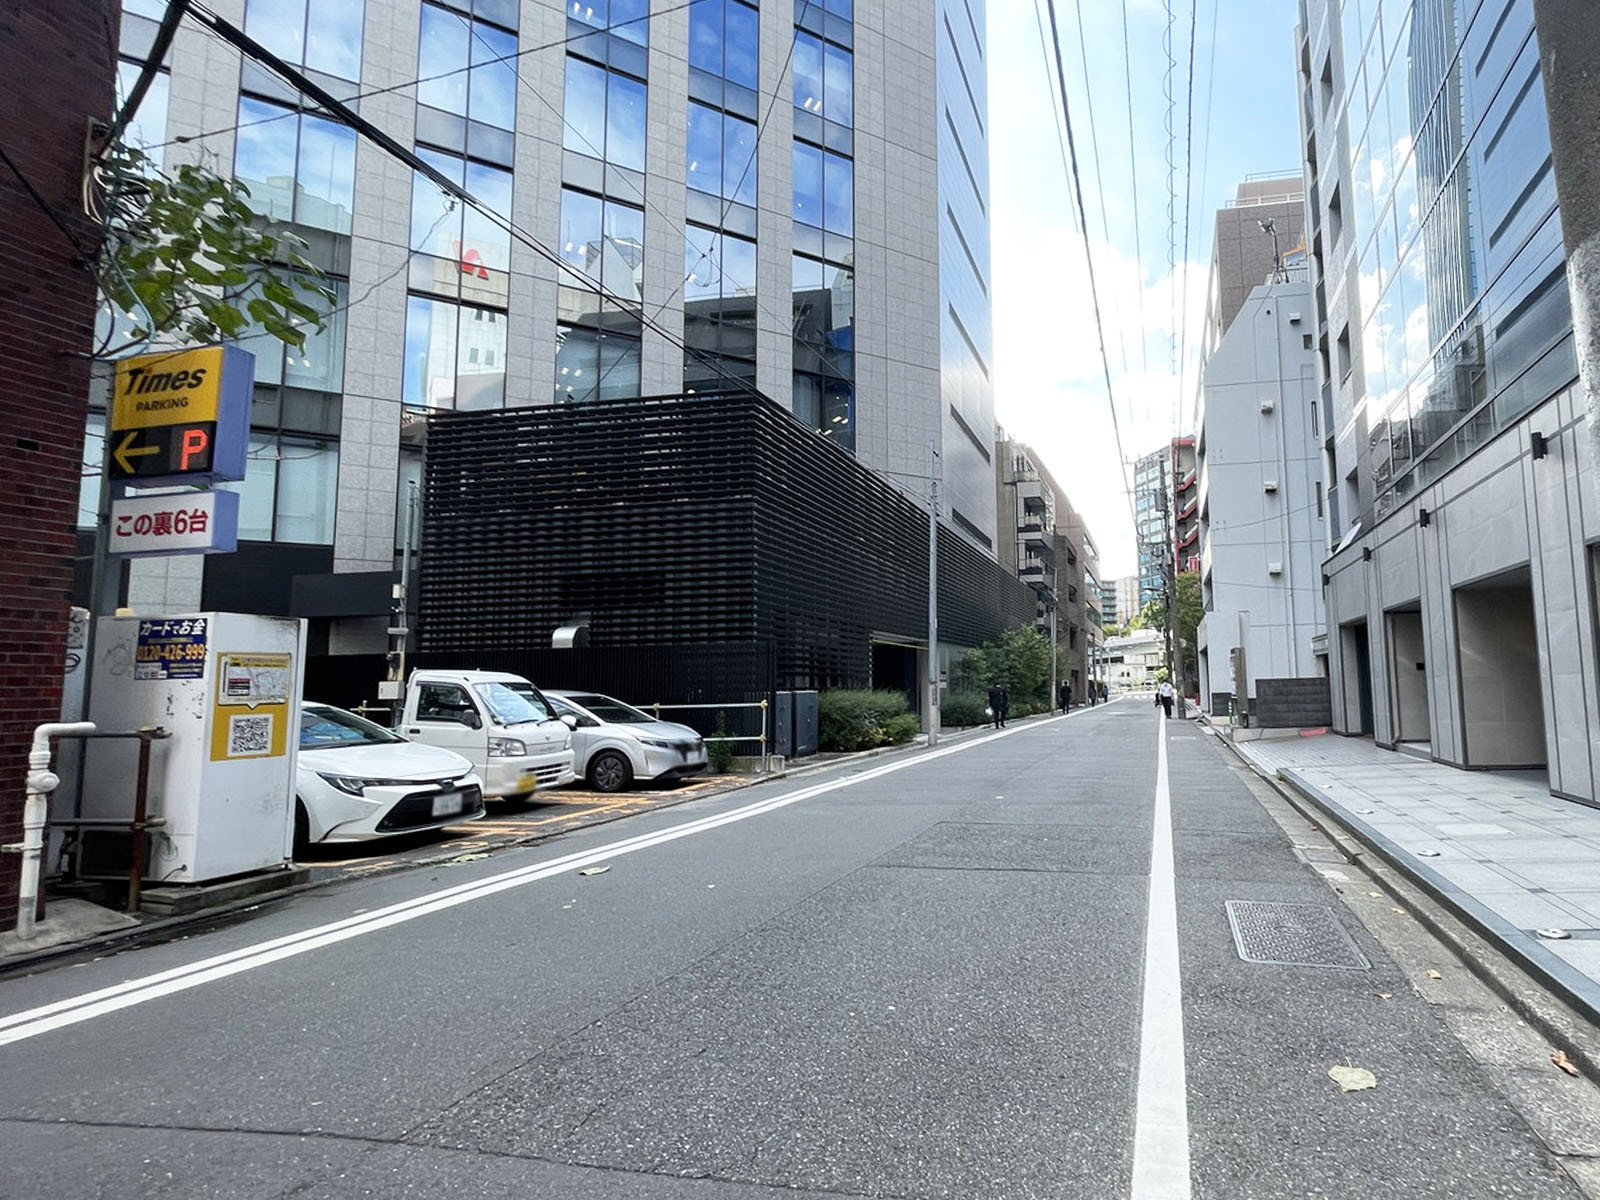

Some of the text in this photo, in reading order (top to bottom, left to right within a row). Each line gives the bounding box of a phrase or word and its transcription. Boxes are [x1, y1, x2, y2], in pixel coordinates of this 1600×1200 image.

[125, 368, 207, 395] Times
[136, 397, 189, 412] PARKING
[180, 429, 208, 471] P
[116, 508, 208, 536] この裏6台
[140, 619, 206, 636] カードでお金
[136, 643, 205, 661] 0120-426-999
